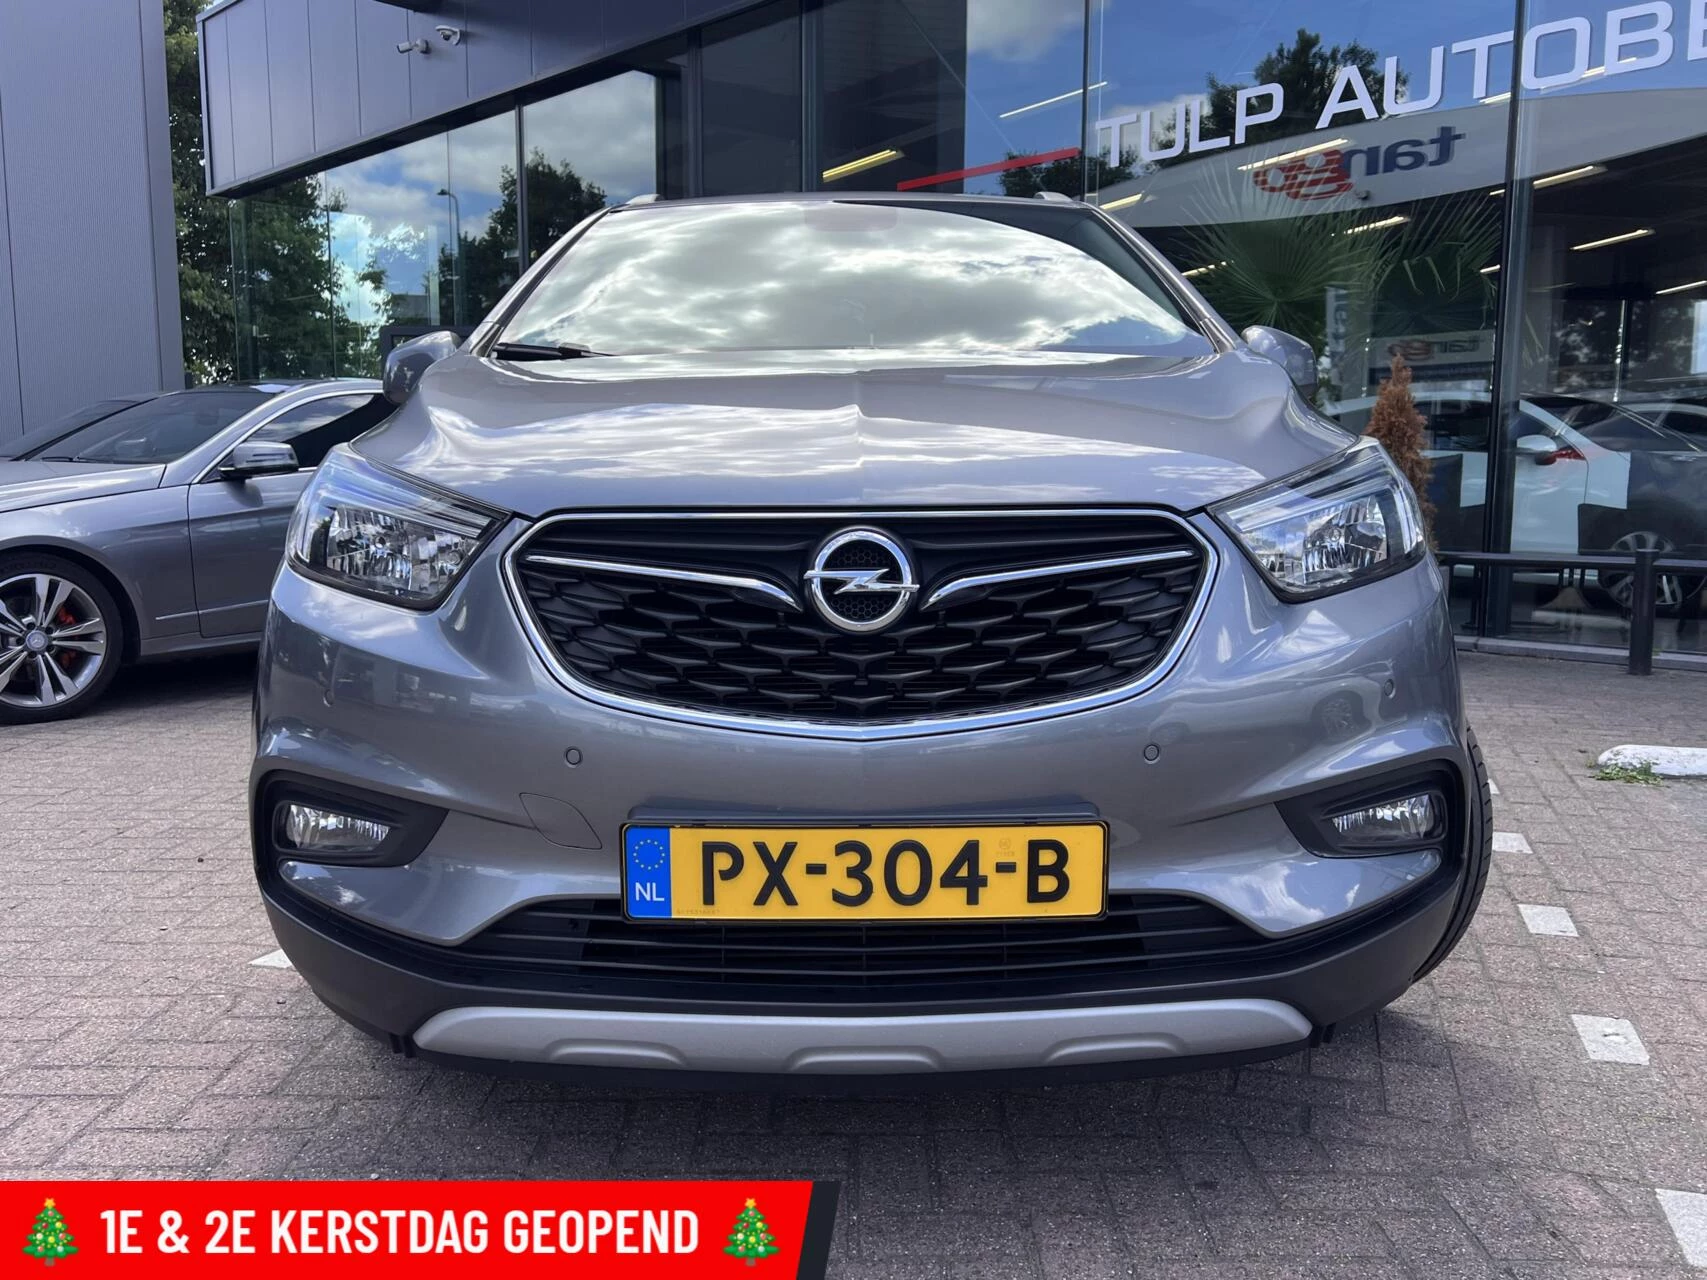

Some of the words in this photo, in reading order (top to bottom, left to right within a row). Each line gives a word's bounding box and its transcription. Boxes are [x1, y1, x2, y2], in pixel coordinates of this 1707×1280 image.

[1095, 83, 1284, 168] TULP
[635, 882, 665, 902] NL
[702, 839, 1070, 907] PX-304-B
